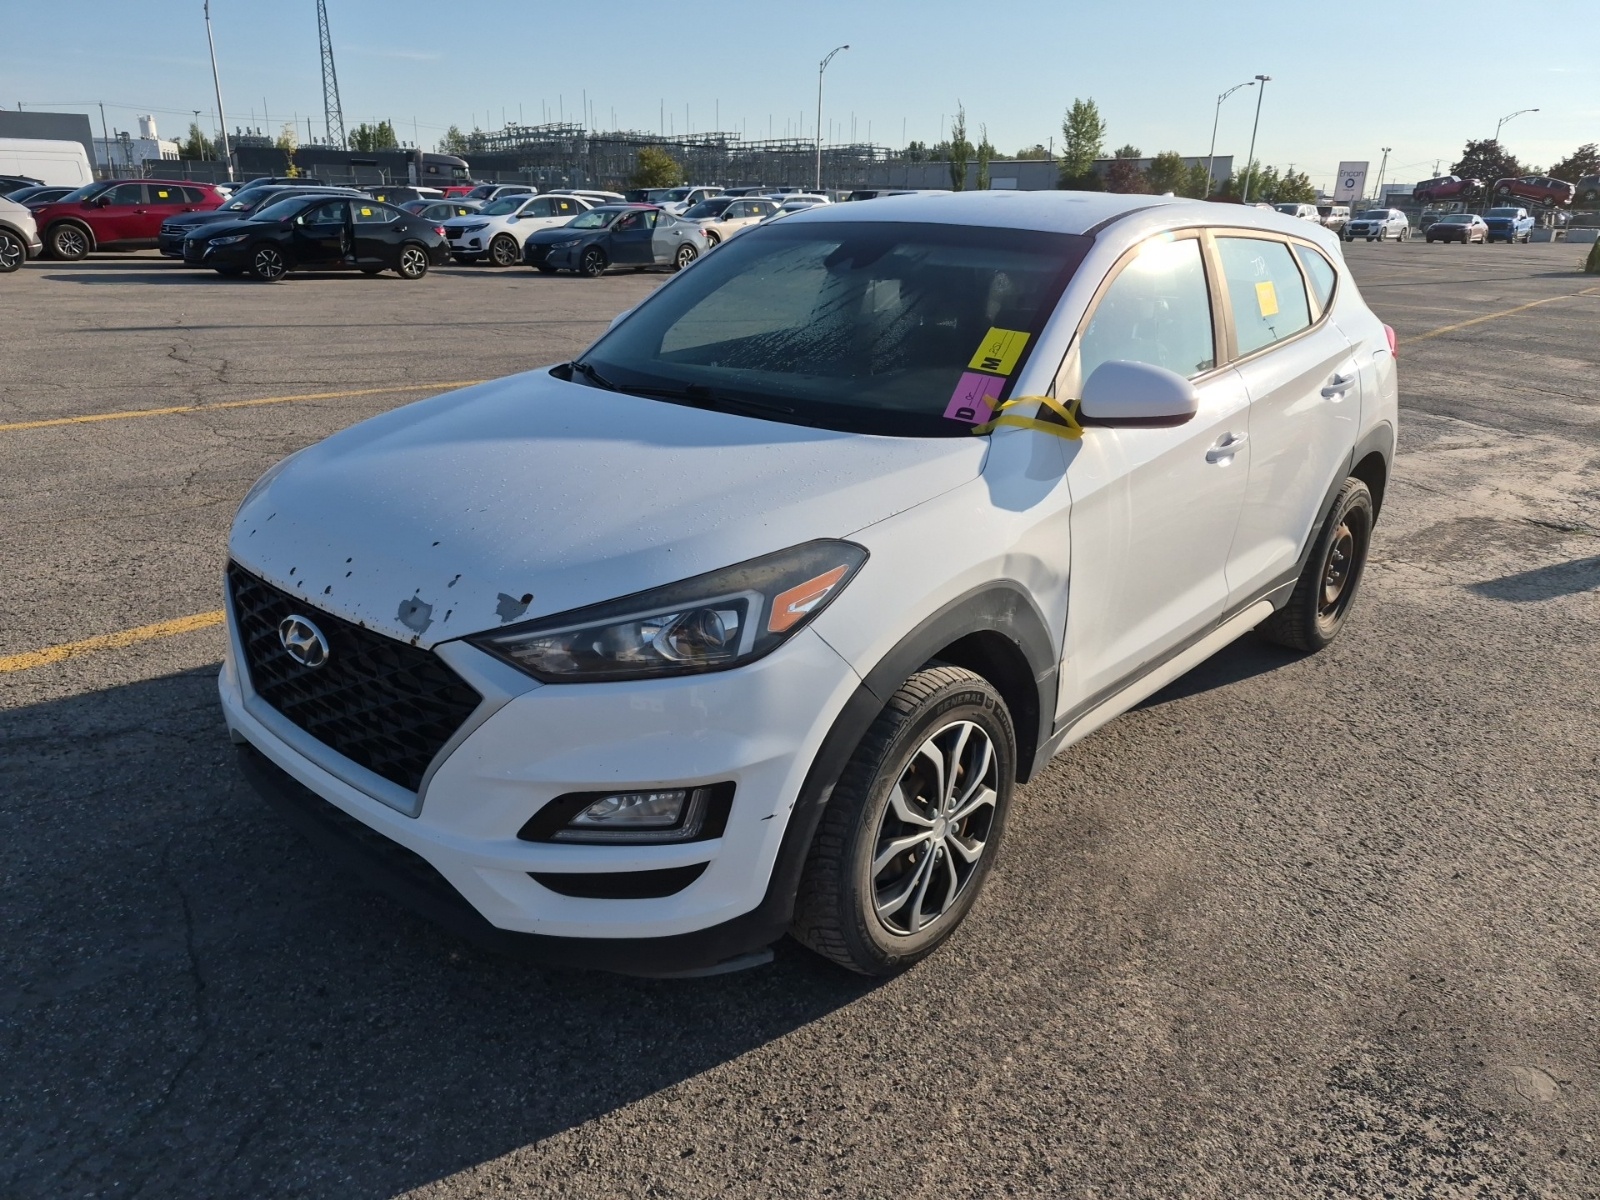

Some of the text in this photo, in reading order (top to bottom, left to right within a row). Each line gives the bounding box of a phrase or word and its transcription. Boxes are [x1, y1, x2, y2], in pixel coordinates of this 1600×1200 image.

[1340, 169, 1364, 177] Encan
[980, 357, 1002, 370] M
[954, 407, 975, 420] D
[936, 693, 982, 714] GENERAL
